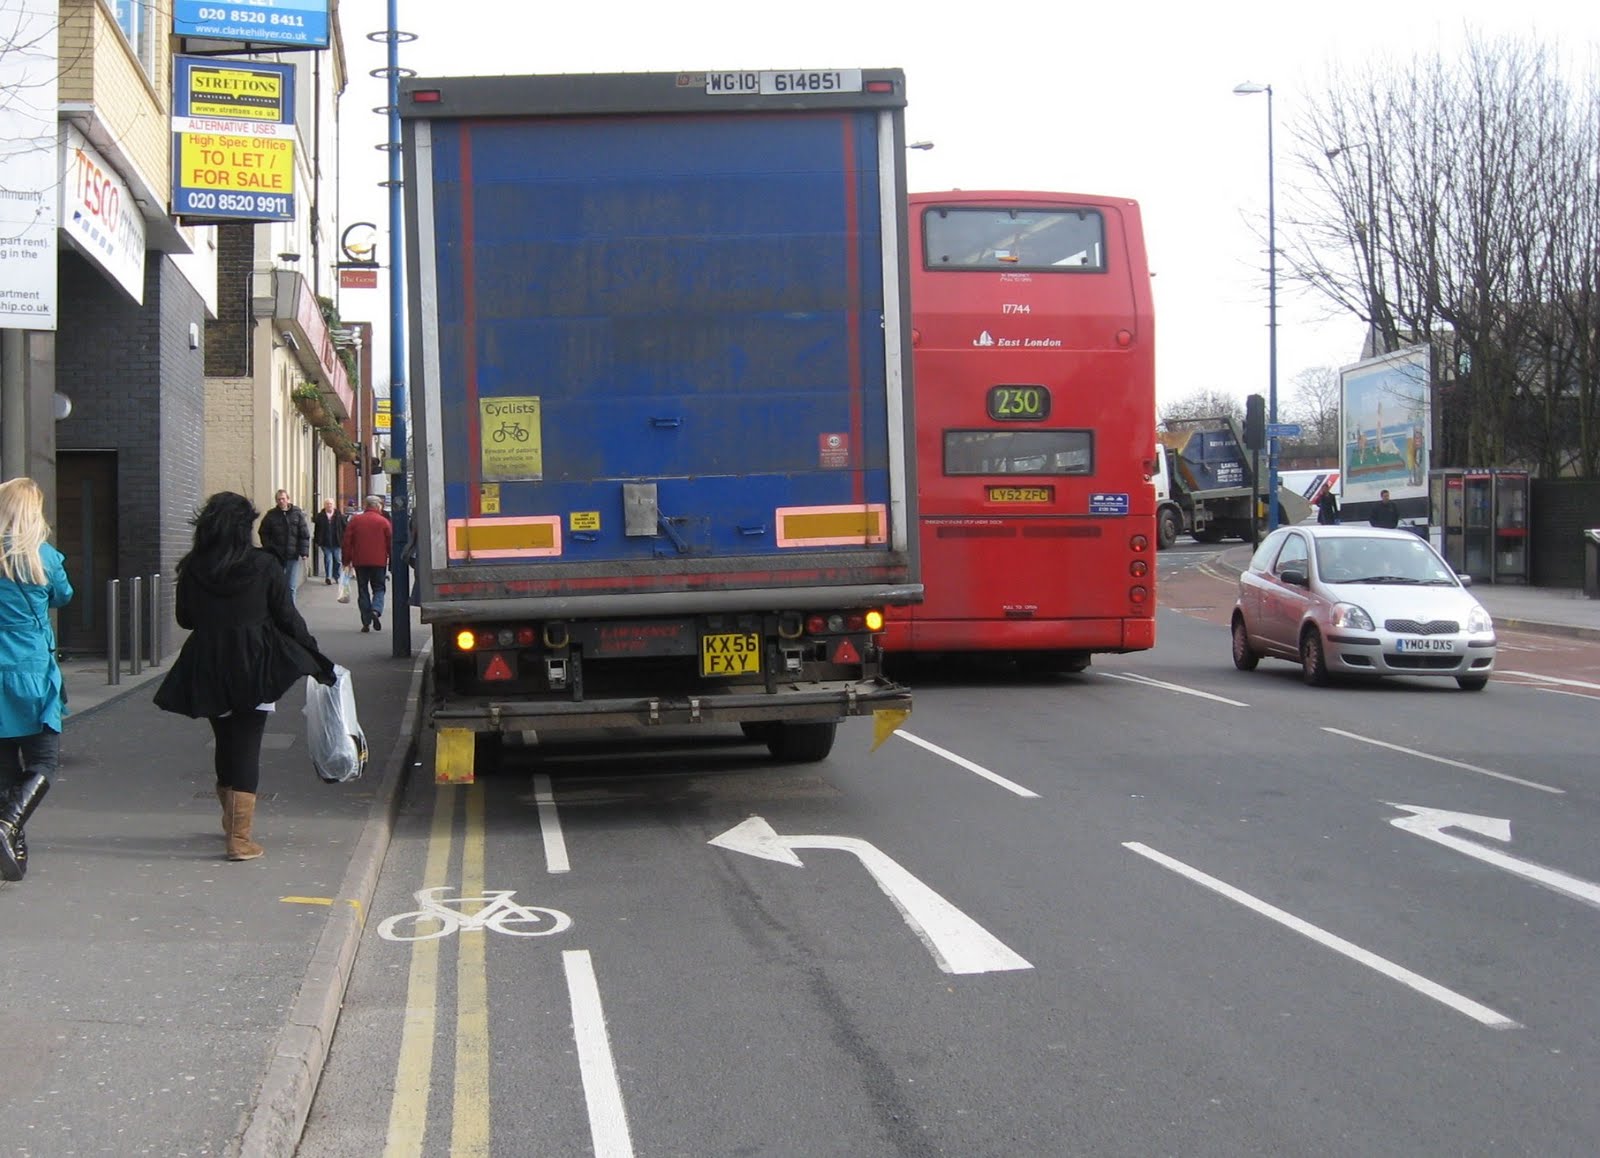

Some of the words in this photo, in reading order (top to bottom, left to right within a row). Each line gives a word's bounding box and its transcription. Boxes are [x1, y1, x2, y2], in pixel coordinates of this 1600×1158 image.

[199, 8, 226, 20] 020
[231, 10, 266, 23] 8520
[270, 13, 304, 27] 8411
[195, 24, 307, 41] www.clarkehillyer.co.uk
[195, 76, 276, 92] STRETTONS
[775, 73, 841, 91] 614851
[188, 120, 250, 133] ALTERNATIVE
[252, 124, 277, 135] USES
[189, 134, 214, 147] High
[219, 135, 248, 149] Spec
[252, 138, 287, 151] Office
[200, 150, 225, 165] TO
[231, 152, 265, 168] LET
[193, 169, 230, 186] FOR
[236, 171, 283, 188] SALE
[76, 147, 119, 233] TESCO
[188, 192, 216, 209] 020
[218, 194, 254, 211] 8520
[256, 196, 287, 213] 9911
[9, 248, 19, 258] in
[21, 249, 38, 259] the
[1002, 303, 1031, 314] 17744
[997, 338, 1020, 347] East
[1024, 338, 1061, 347] London
[485, 403, 535, 416] Cyclists
[996, 389, 1039, 413] 230
[991, 489, 1022, 501] LY52
[1024, 489, 1047, 501] ZFC
[705, 636, 757, 653] KX56
[1433, 640, 1452, 650] DXS
[710, 654, 748, 671] FXY
